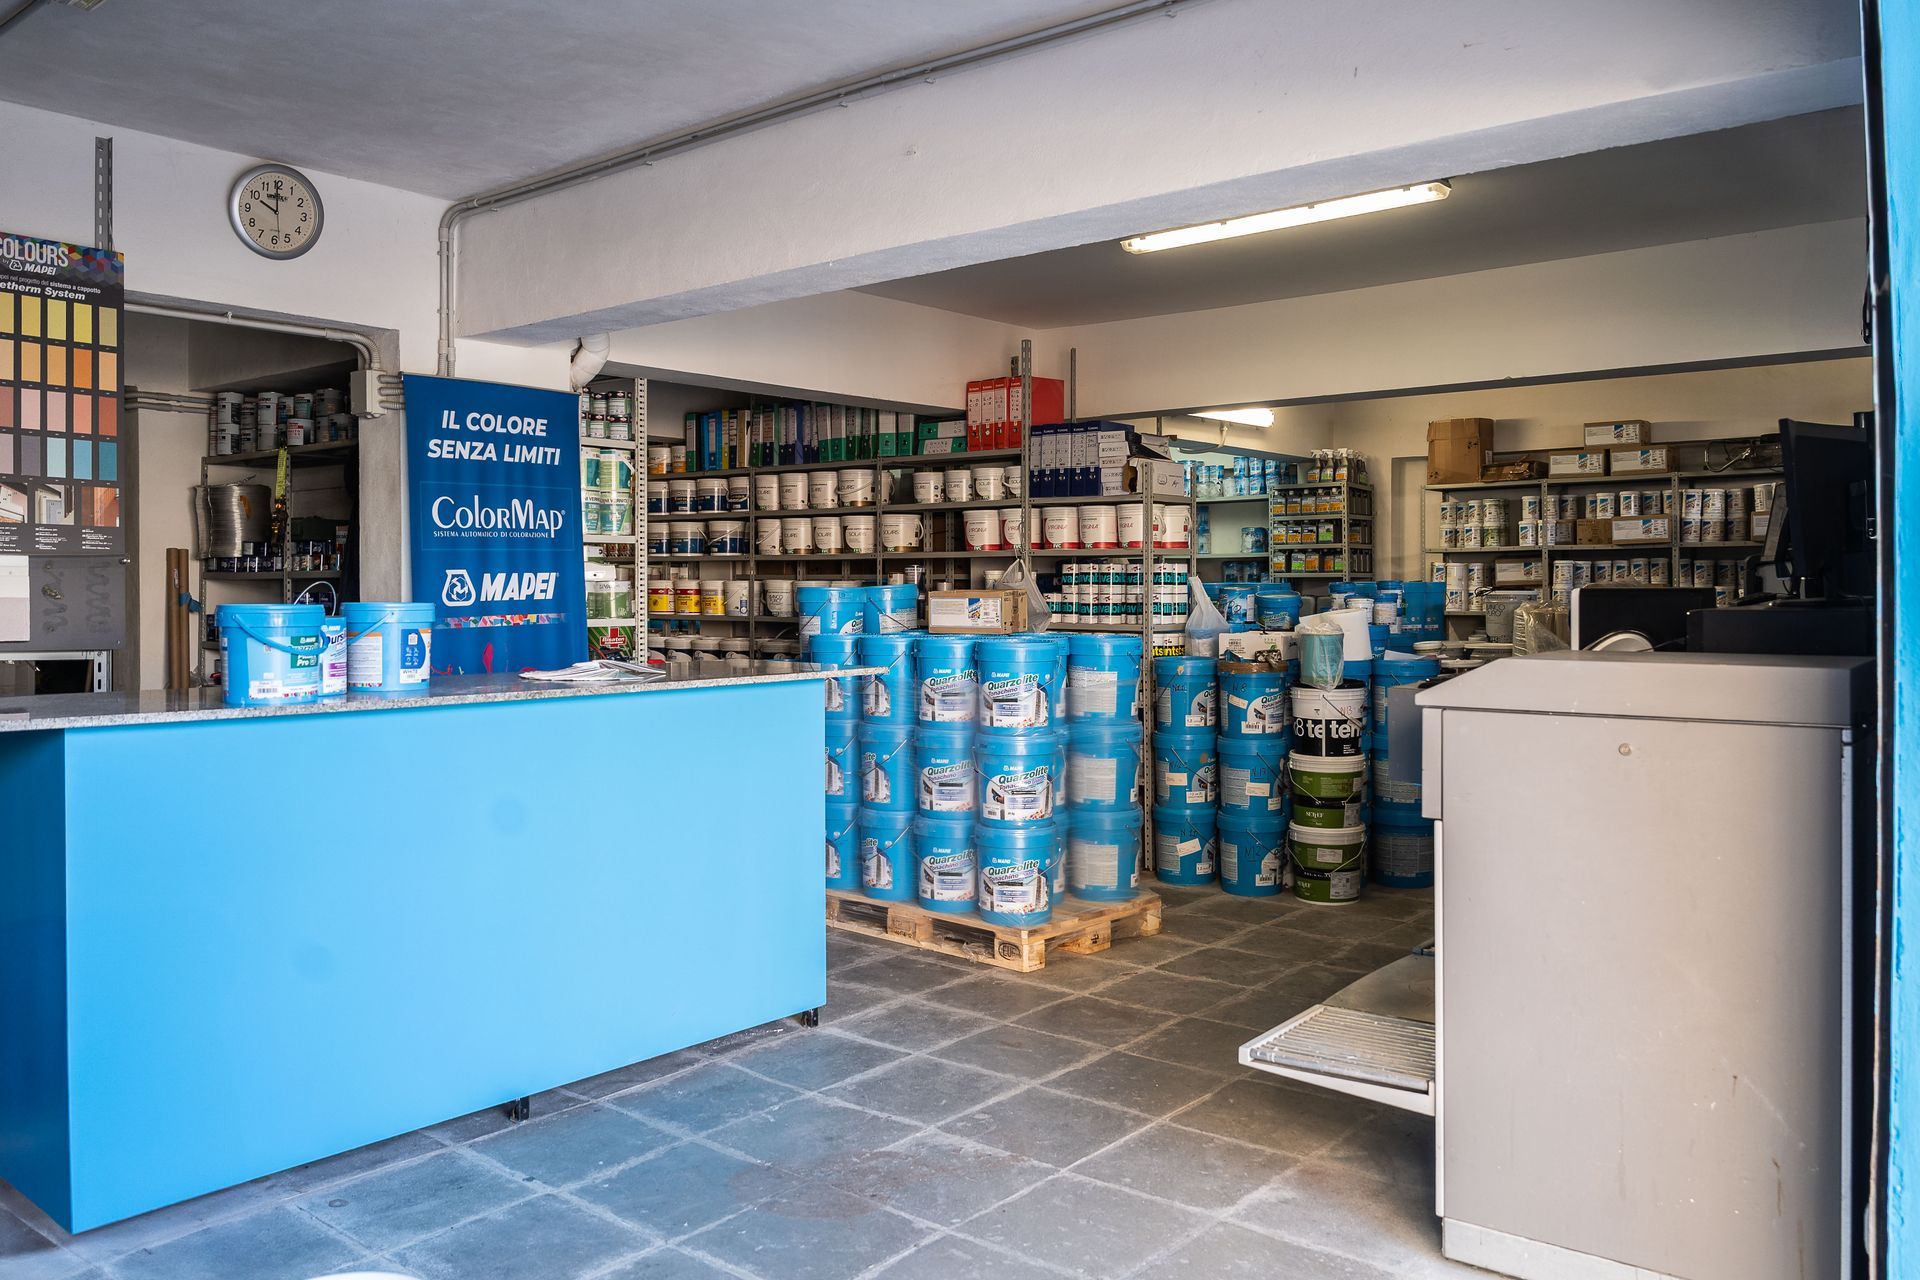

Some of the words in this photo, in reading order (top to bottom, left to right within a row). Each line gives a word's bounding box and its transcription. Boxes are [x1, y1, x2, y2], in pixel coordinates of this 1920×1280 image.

[261, 181, 269, 191] 11
[273, 180, 283, 191] 12
[289, 186, 294, 196] 1
[250, 189, 260, 200] 10
[244, 203, 251, 212] 9
[297, 198, 304, 207] 2
[248, 218, 256, 227] 8
[300, 212, 307, 222] 3
[258, 229, 264, 239] 7
[295, 226, 302, 235] 4
[271, 235, 278, 245] 6
[283, 234, 291, 243] 5
[0, 237, 68, 267] OLOURS
[24, 262, 57, 276] MAPEI
[44, 286, 86, 300] System
[50, 281, 71, 290] sistema
[77, 286, 101, 294] cappotto
[442, 410, 460, 430] IL
[466, 412, 548, 437] COLORE
[427, 439, 497, 462] SENZA
[503, 443, 561, 466] LIMITI
[433, 530, 459, 538] SISTEMA
[460, 530, 498, 538] AUTOMATICO
[509, 531, 549, 539] COLORAZIONE
[479, 572, 557, 602] MAPEI
[929, 670, 978, 687] Quarzolite
[987, 674, 1039, 691] Quarzolite
[998, 766, 1049, 784] Quarzolite
[988, 860, 1039, 876] Quarzolite
